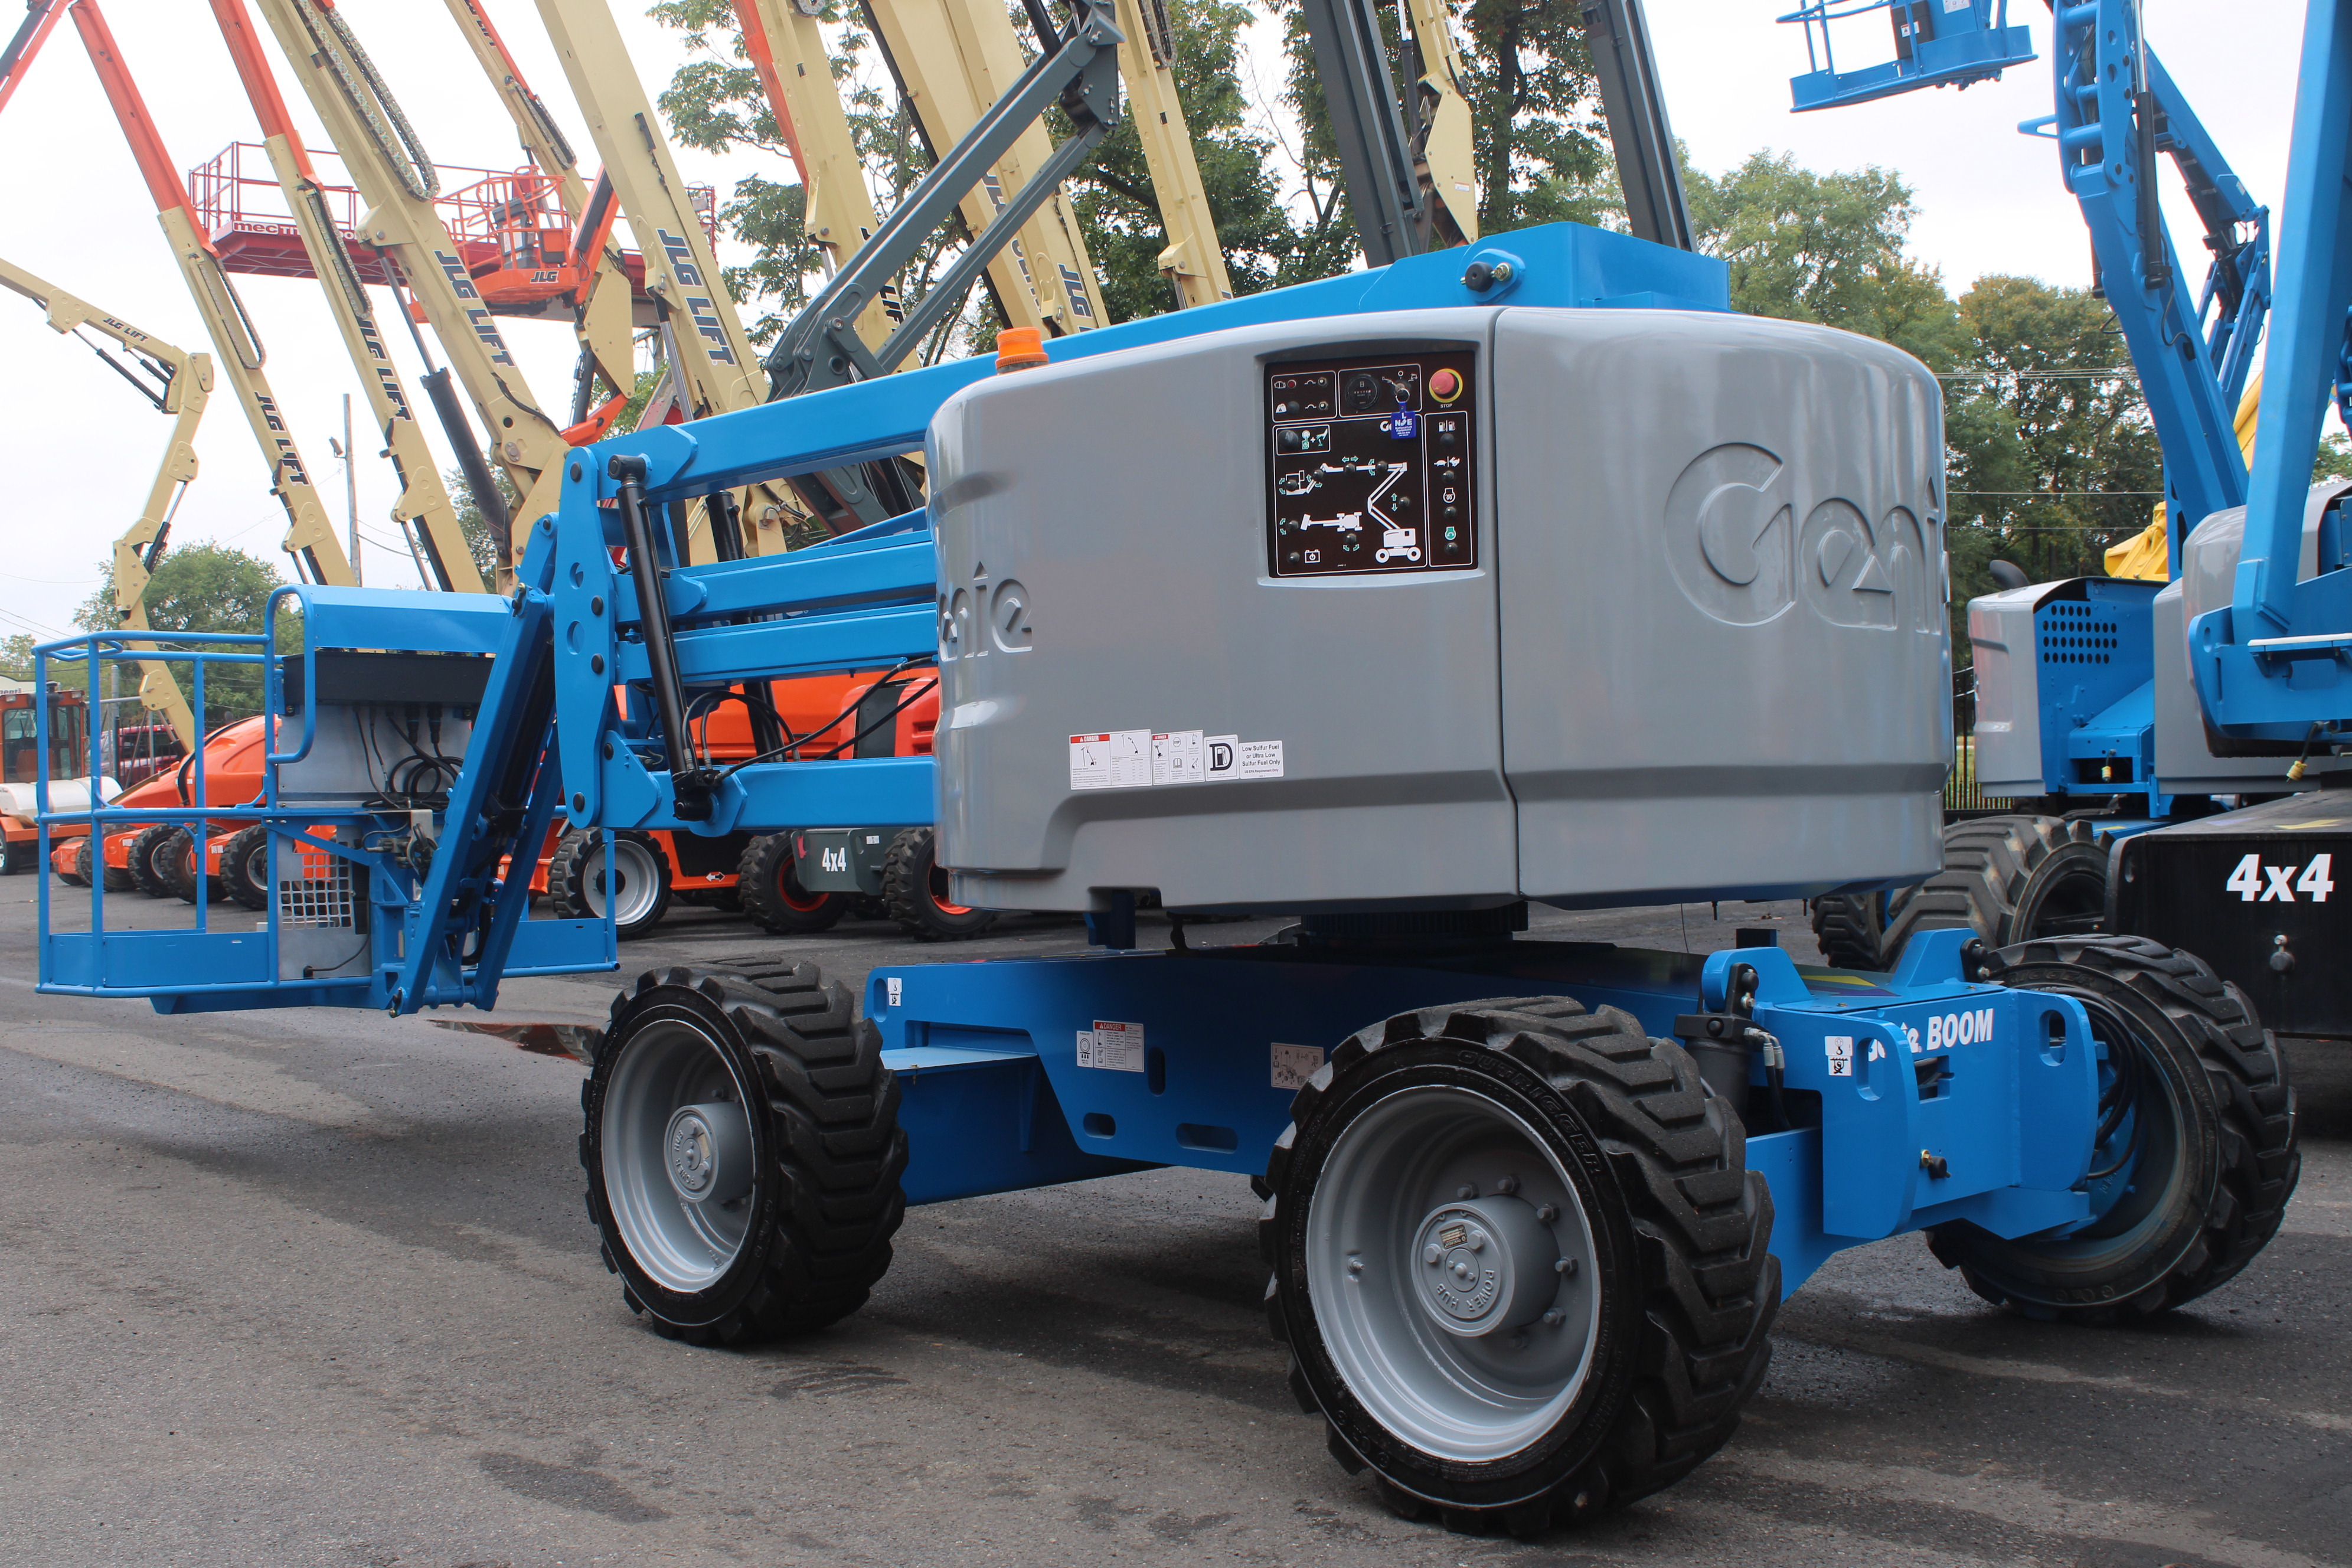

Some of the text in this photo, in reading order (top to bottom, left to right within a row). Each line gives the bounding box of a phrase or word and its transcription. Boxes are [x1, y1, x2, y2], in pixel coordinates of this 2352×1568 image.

[234, 221, 279, 234] mec
[530, 270, 559, 284] JLG
[656, 228, 737, 367] JLG LIFT
[1057, 263, 1093, 319] JLG
[103, 317, 149, 342] JLG LIFT
[433, 250, 517, 367] JLG LIFT
[879, 285, 906, 332] LIF
[254, 391, 311, 486] JLG LIFT
[939, 561, 1033, 662] enie
[822, 847, 847, 872] 4x4
[2226, 854, 2335, 902] 4x4
[1103, 1023, 1122, 1031] DANGER
[1927, 1008, 1994, 1050] BOOM
[1458, 1050, 1603, 1175] OUTRIGGER
[673, 1129, 684, 1152] HUB
[675, 1157, 695, 1186] POWER
[1436, 1269, 1495, 1312] POWER HUB
